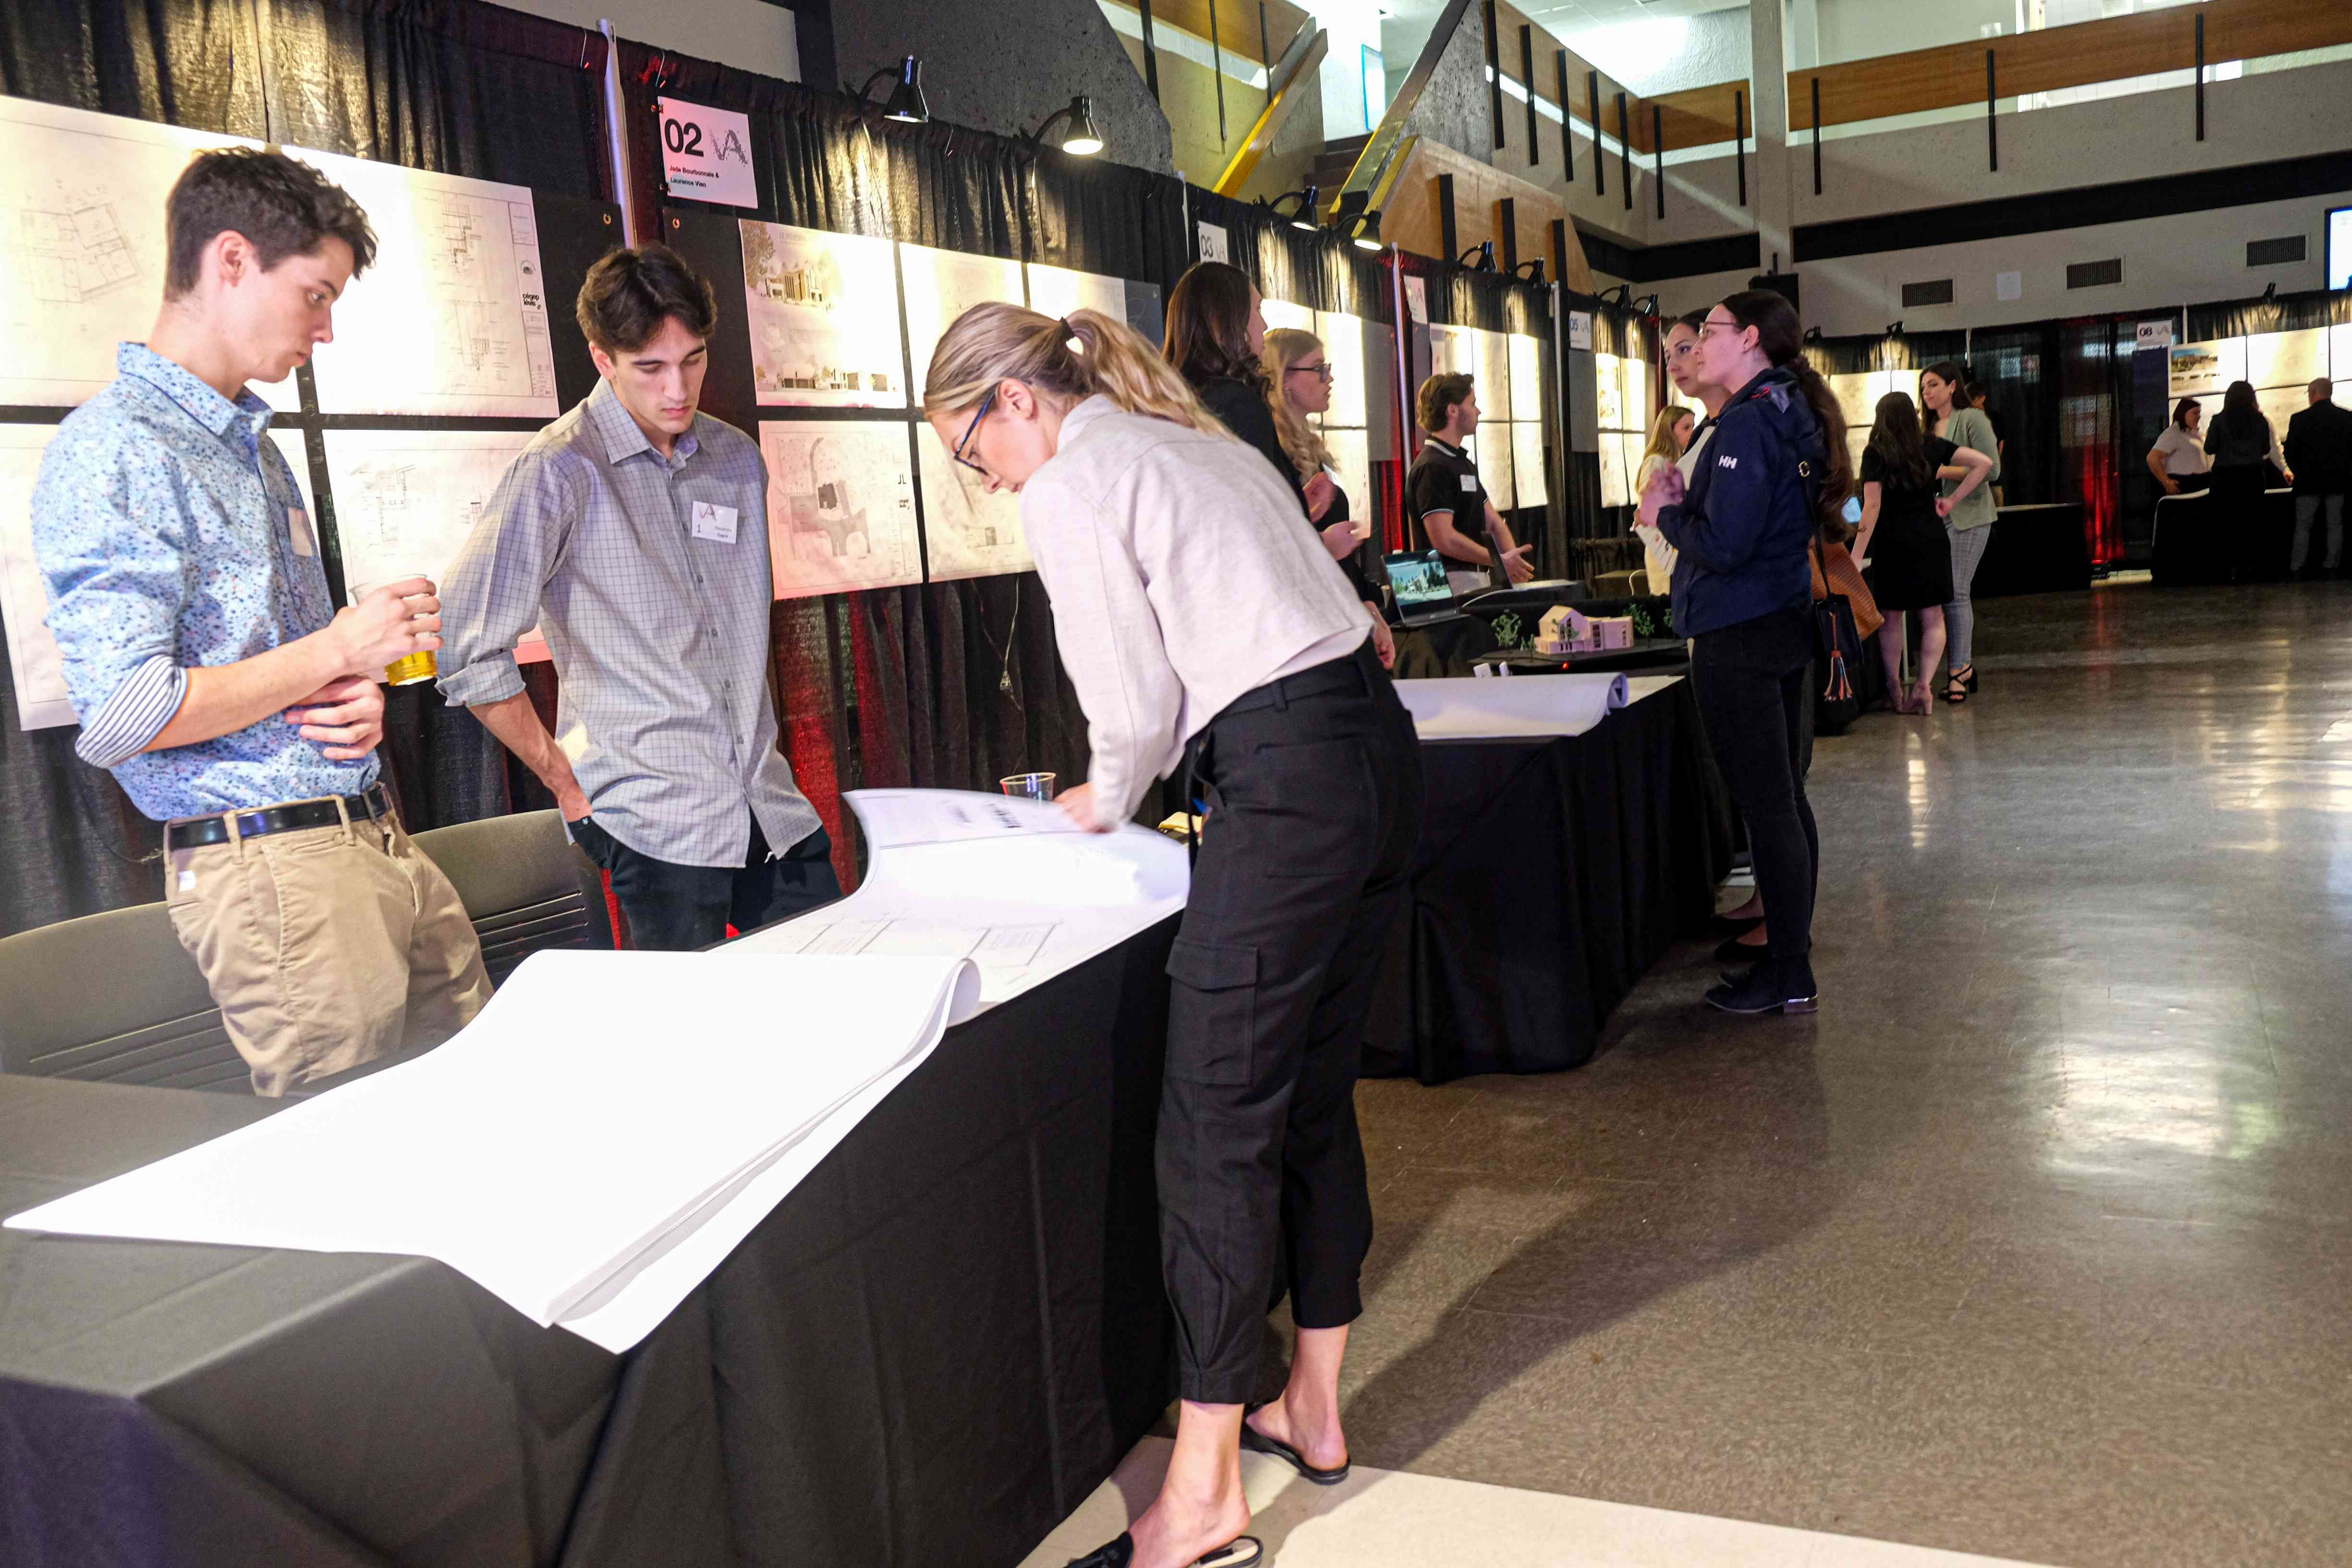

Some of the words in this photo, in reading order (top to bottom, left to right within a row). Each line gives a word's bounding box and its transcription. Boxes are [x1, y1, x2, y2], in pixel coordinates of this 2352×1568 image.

[664, 118, 704, 158] 02
[670, 177, 694, 186] Laurence
[1200, 234, 1213, 258] 03
[1569, 318, 1579, 331] 05
[1718, 455, 1738, 469] HH
